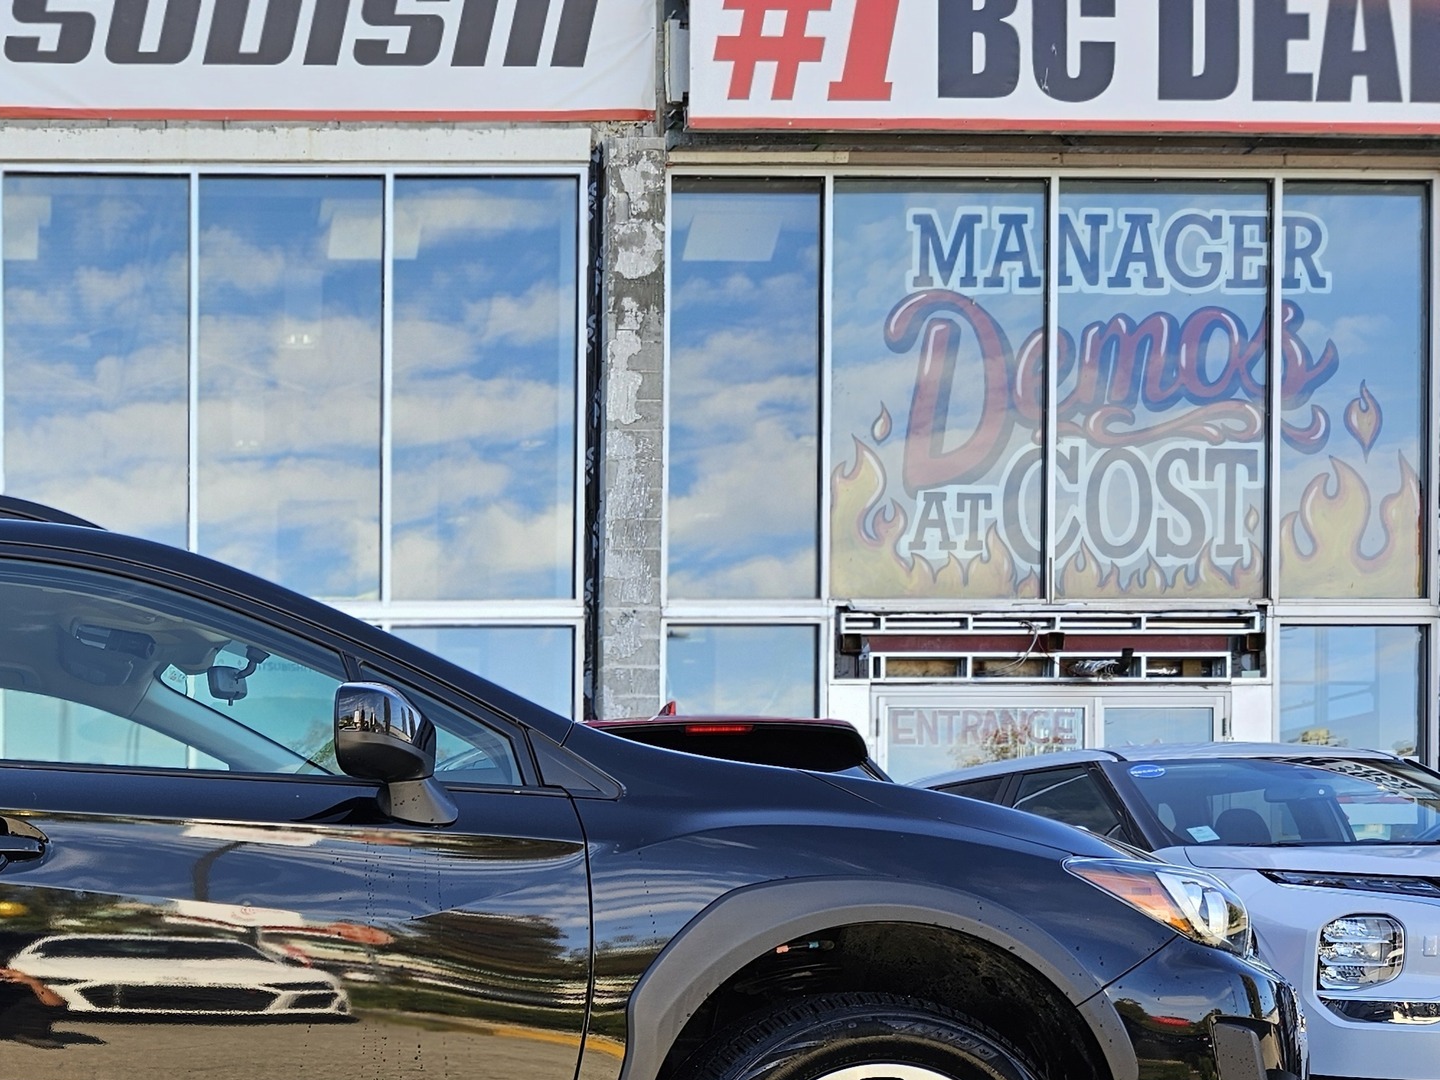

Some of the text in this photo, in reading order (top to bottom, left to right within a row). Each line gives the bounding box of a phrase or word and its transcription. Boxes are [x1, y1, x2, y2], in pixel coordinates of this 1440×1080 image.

[713, 0, 900, 101] #1
[937, 0, 1116, 101] BC
[908, 208, 1331, 293] MANAGER
[884, 289, 1338, 493] Demos
[909, 443, 1262, 565] AT COST
[890, 708, 1077, 746] ENTRANCE
